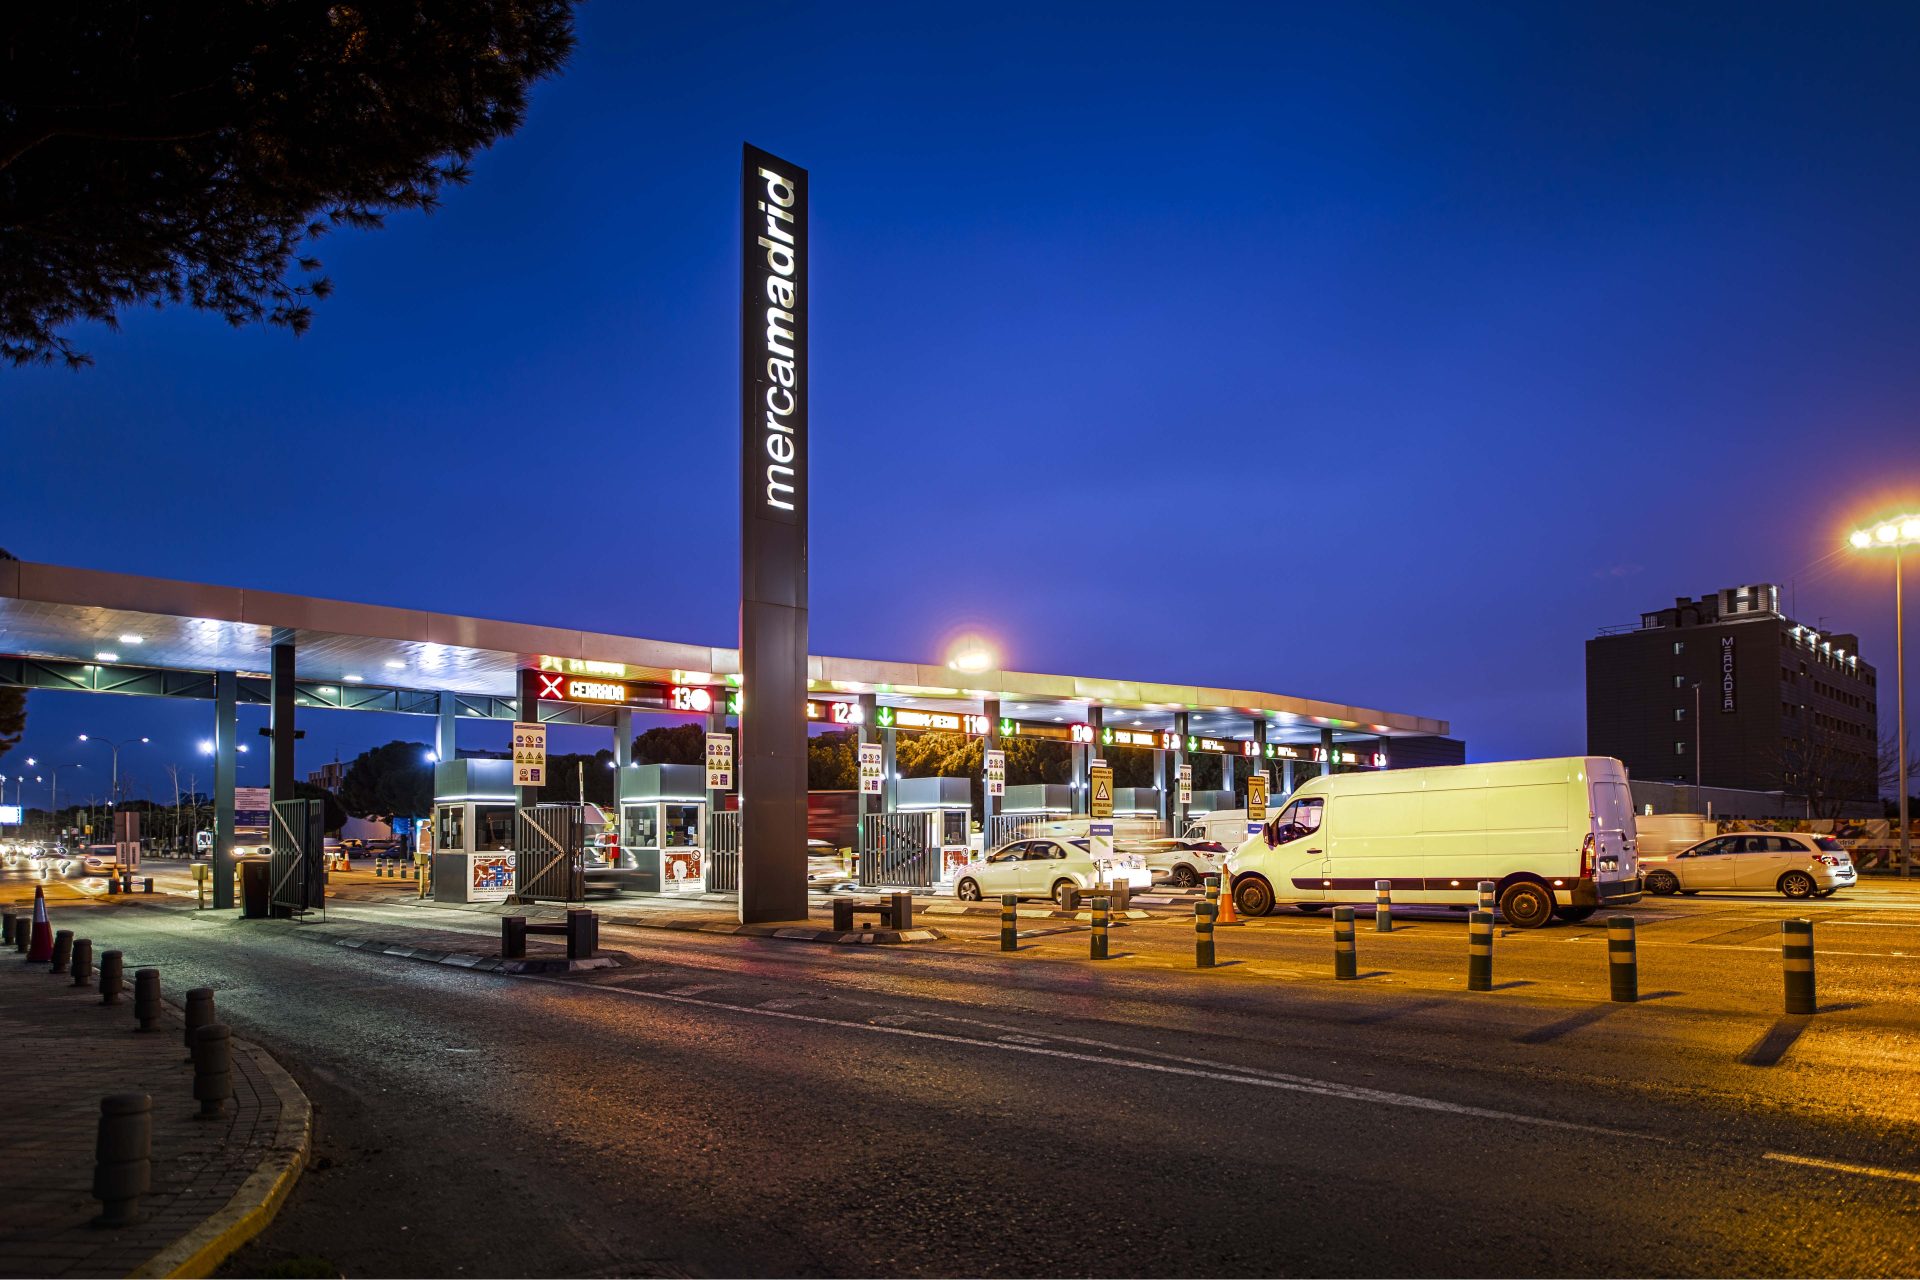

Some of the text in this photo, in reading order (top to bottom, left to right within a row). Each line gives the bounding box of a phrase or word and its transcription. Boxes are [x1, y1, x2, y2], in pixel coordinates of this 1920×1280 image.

[758, 166, 795, 511] mercamadrid
[1727, 586, 1759, 613] H
[570, 682, 625, 700] CERRADA
[1721, 636, 1734, 709] MERCADER
